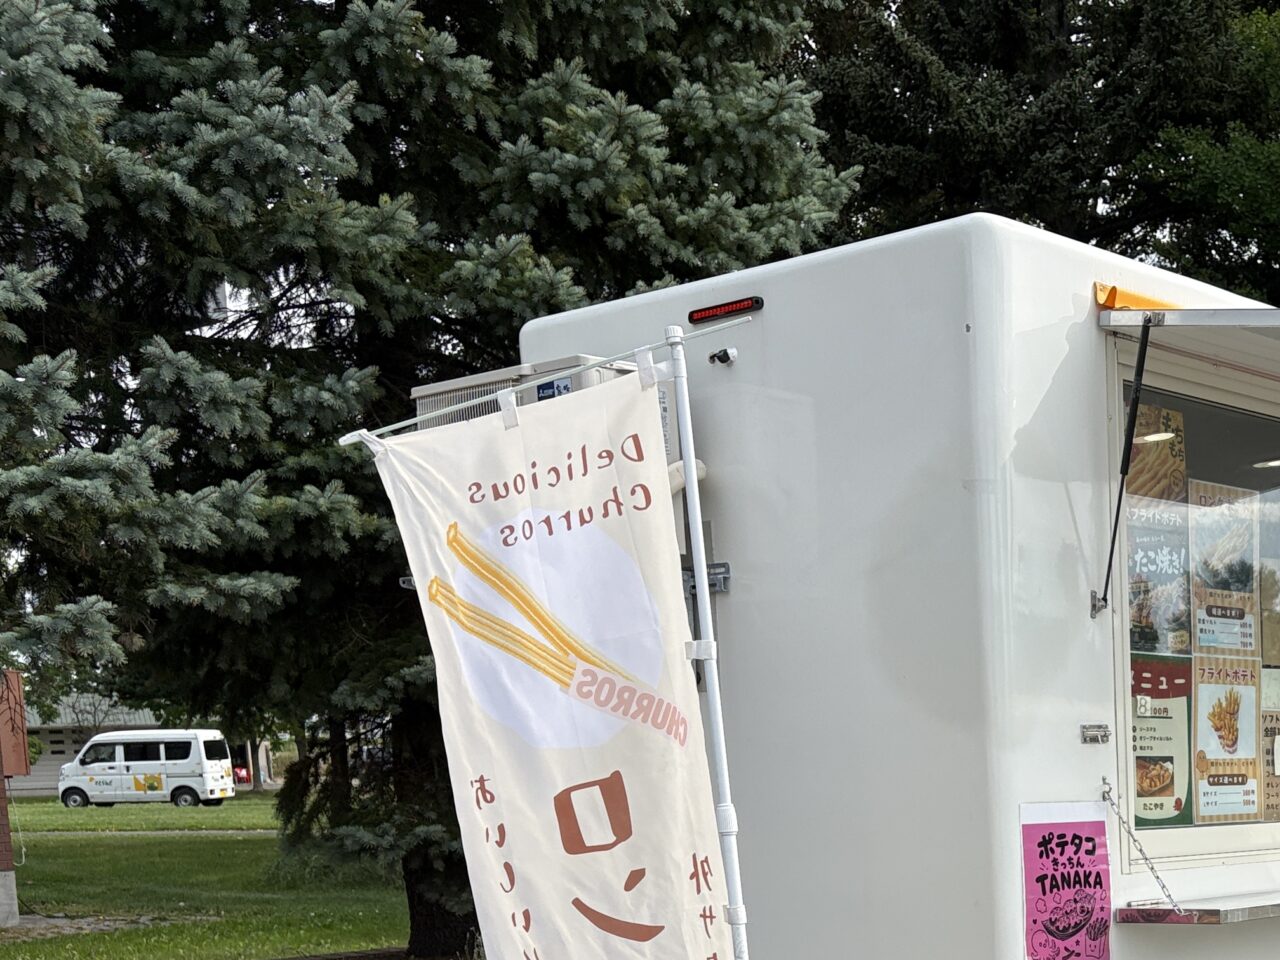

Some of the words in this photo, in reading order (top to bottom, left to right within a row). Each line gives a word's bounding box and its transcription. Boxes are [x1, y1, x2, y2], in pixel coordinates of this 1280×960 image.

[1037, 831, 1097, 859] ポテタコ
[1051, 856, 1084, 872] きっちん
[1035, 870, 1104, 897] TANAKA
